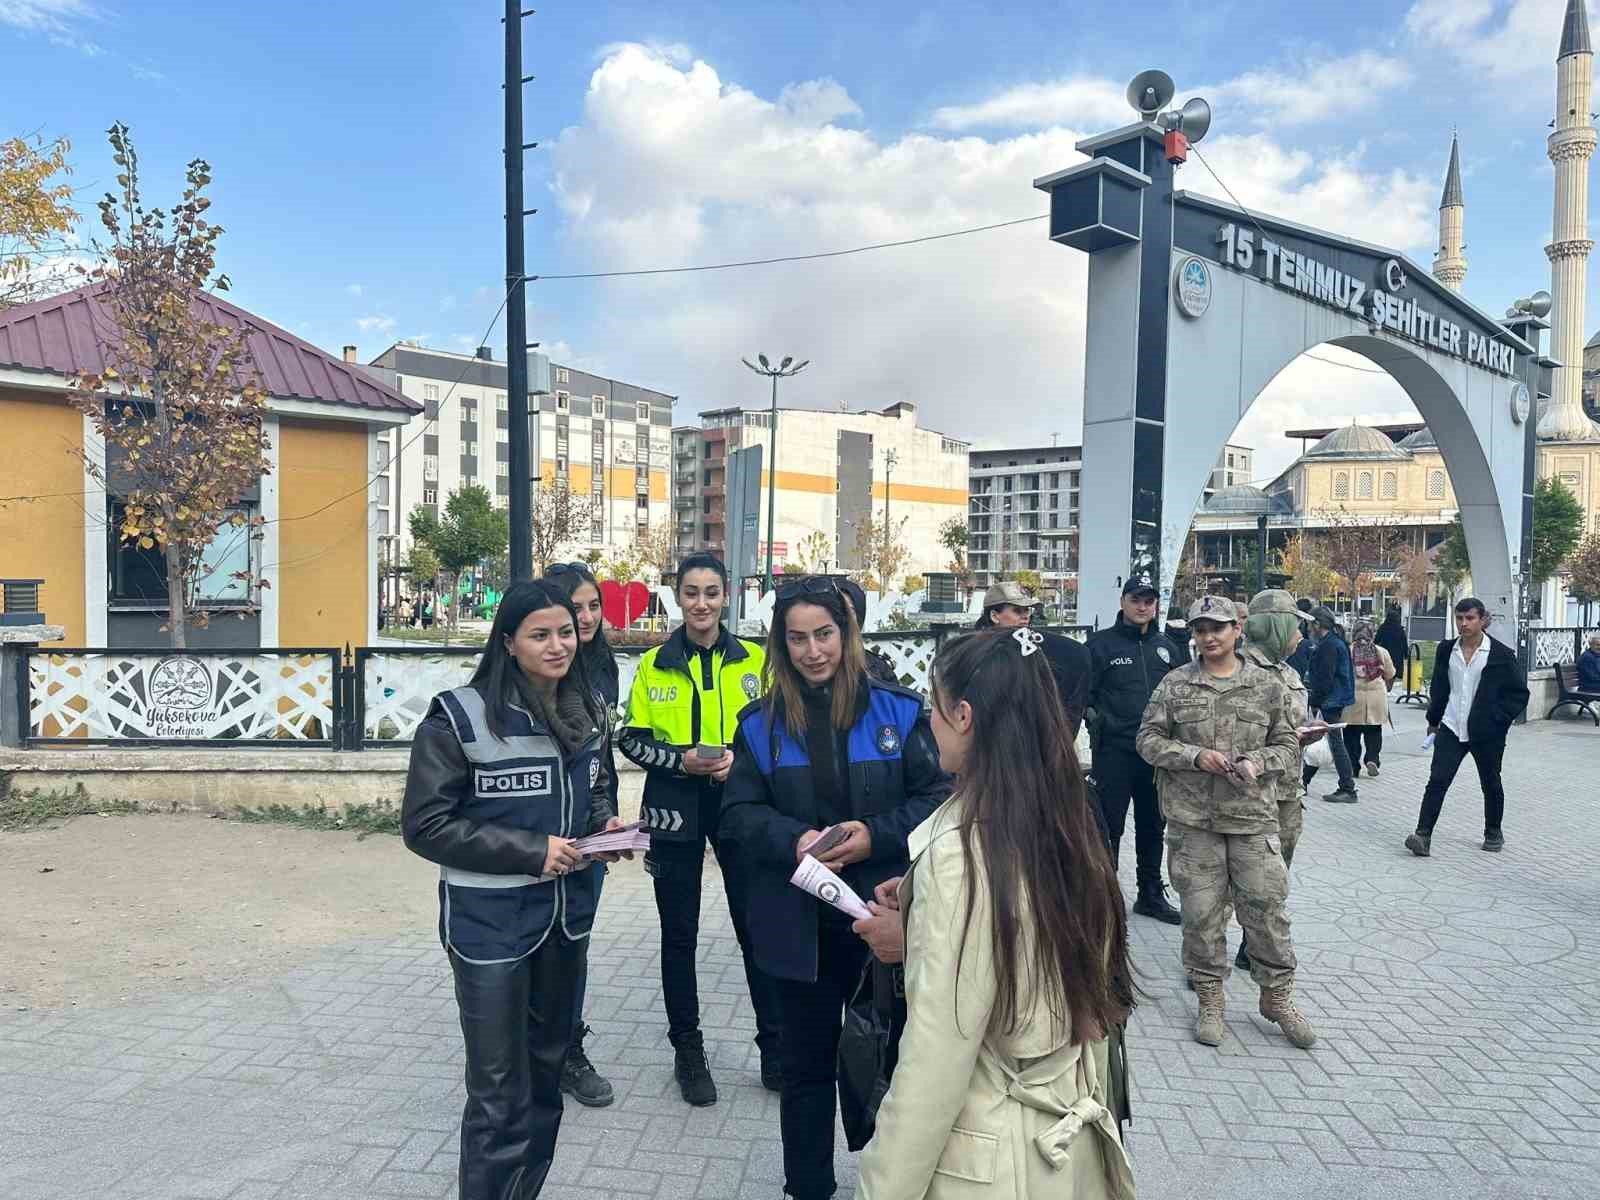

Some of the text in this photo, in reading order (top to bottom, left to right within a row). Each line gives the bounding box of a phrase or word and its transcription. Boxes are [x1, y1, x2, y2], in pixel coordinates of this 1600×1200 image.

[1219, 223, 1516, 376] 15 TEMMUZ ŞEHİTLER PARKI
[647, 686, 678, 701] OLİS
